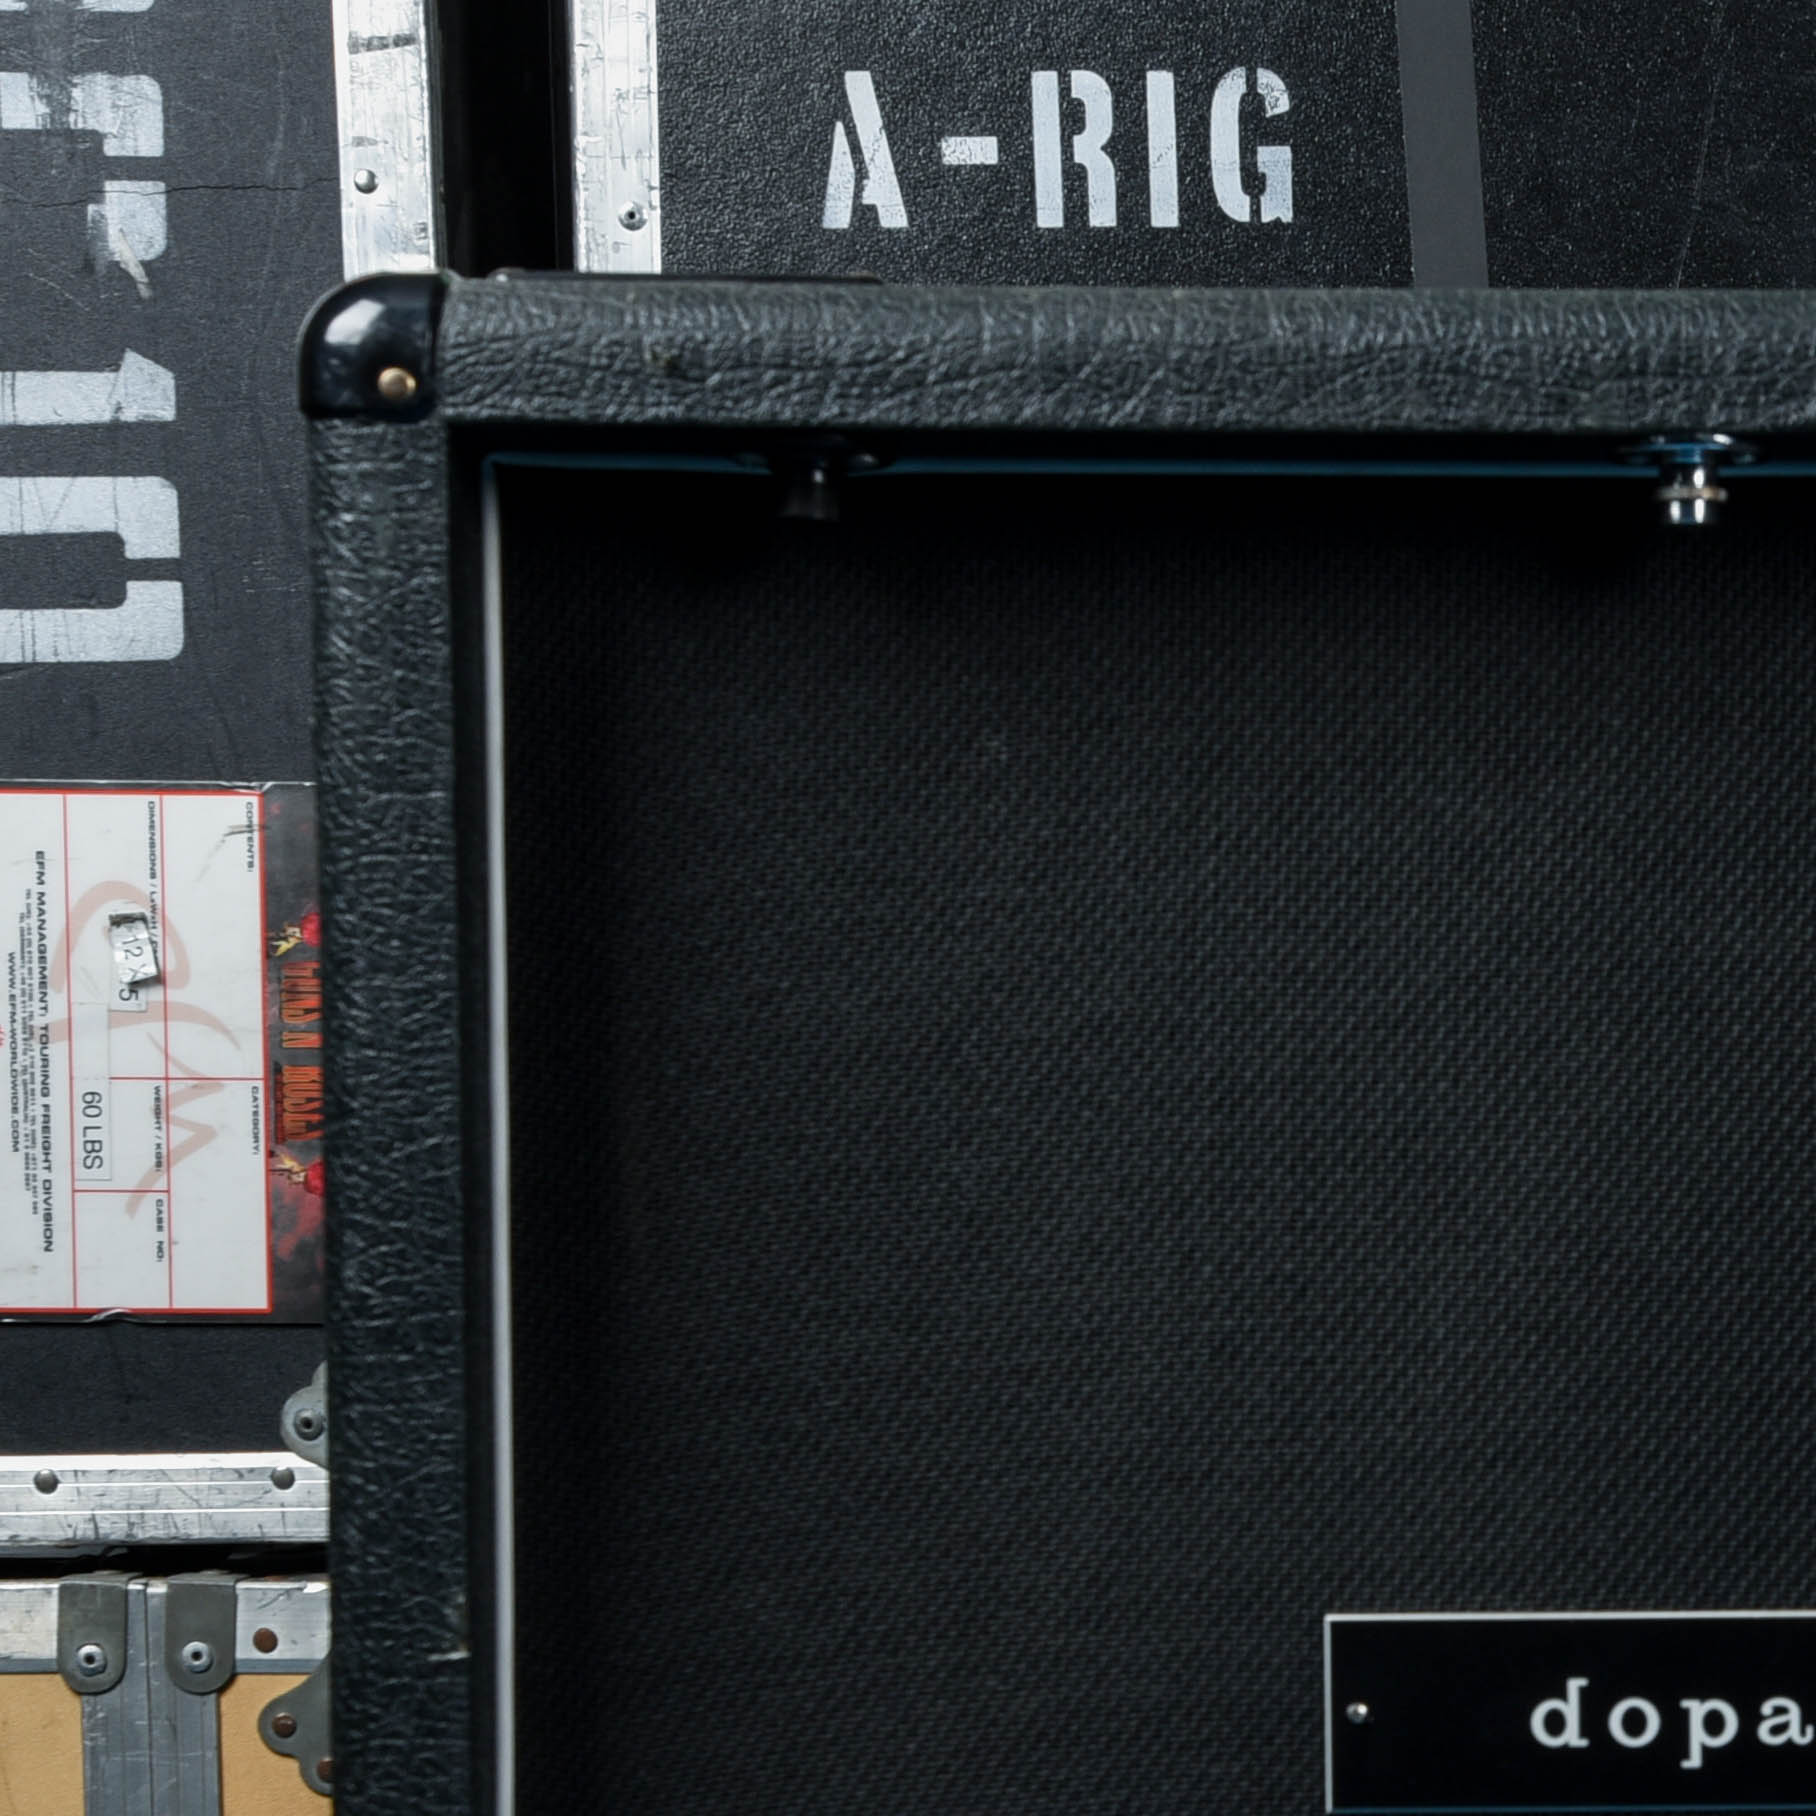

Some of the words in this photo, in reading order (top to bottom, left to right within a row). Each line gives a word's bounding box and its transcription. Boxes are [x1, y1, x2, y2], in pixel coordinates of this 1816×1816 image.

[820, 66, 1294, 229] A-RIG
[35, 850, 47, 885] EFM
[147, 800, 158, 880] DIMENSIONS
[36, 890, 50, 1017] MANAGEMENT:
[39, 1023, 52, 1098] TOURING
[81, 1091, 102, 1119] 60
[153, 1085, 163, 1132] WEIGHT
[250, 1085, 261, 1156] CATEGORY:
[40, 1103, 52, 1174] FREIGHT
[82, 1126, 104, 1169] LBS
[154, 1143, 163, 1172] KGS:
[42, 1179, 54, 1253] DIVISION
[155, 1198, 165, 1234] CASE
[155, 1240, 165, 1263] NO:
